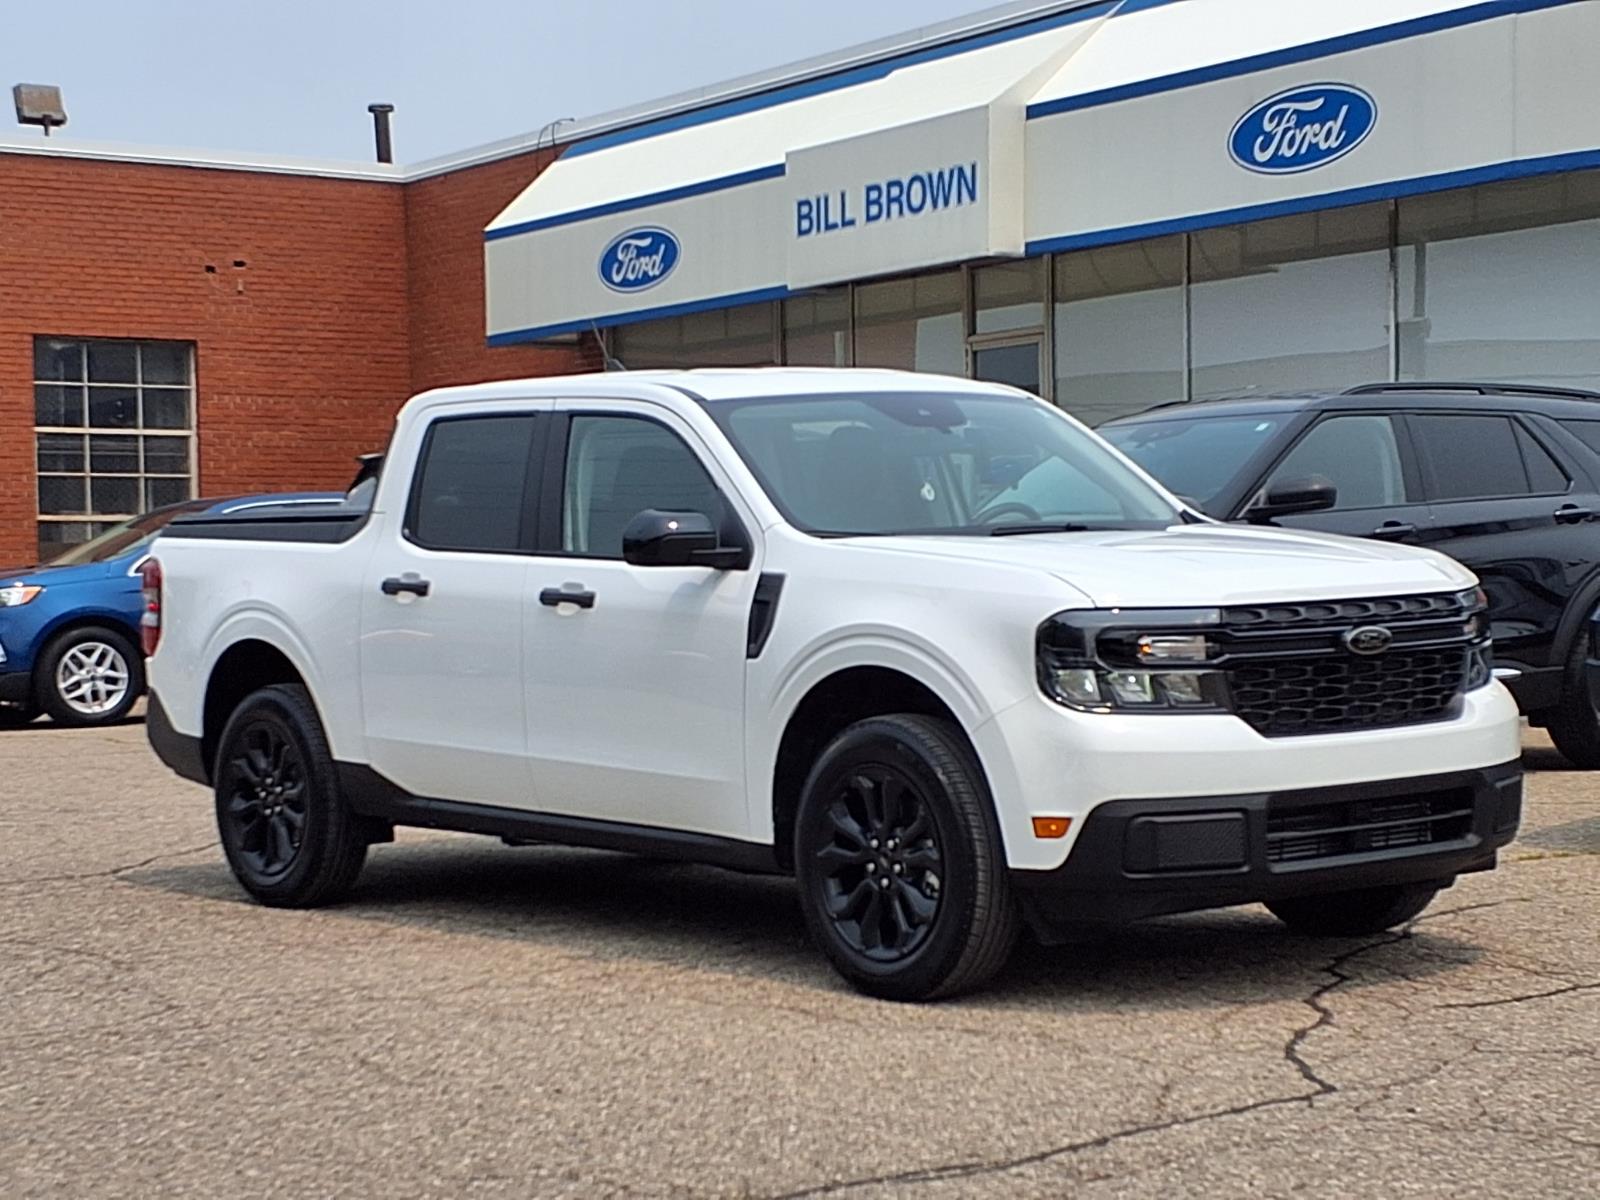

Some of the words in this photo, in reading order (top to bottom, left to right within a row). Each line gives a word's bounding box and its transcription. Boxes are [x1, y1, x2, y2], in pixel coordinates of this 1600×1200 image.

[1253, 96, 1349, 163] Ford
[796, 190, 856, 238] BILL
[864, 161, 977, 224] BROWN
[611, 236, 666, 283] Ford
